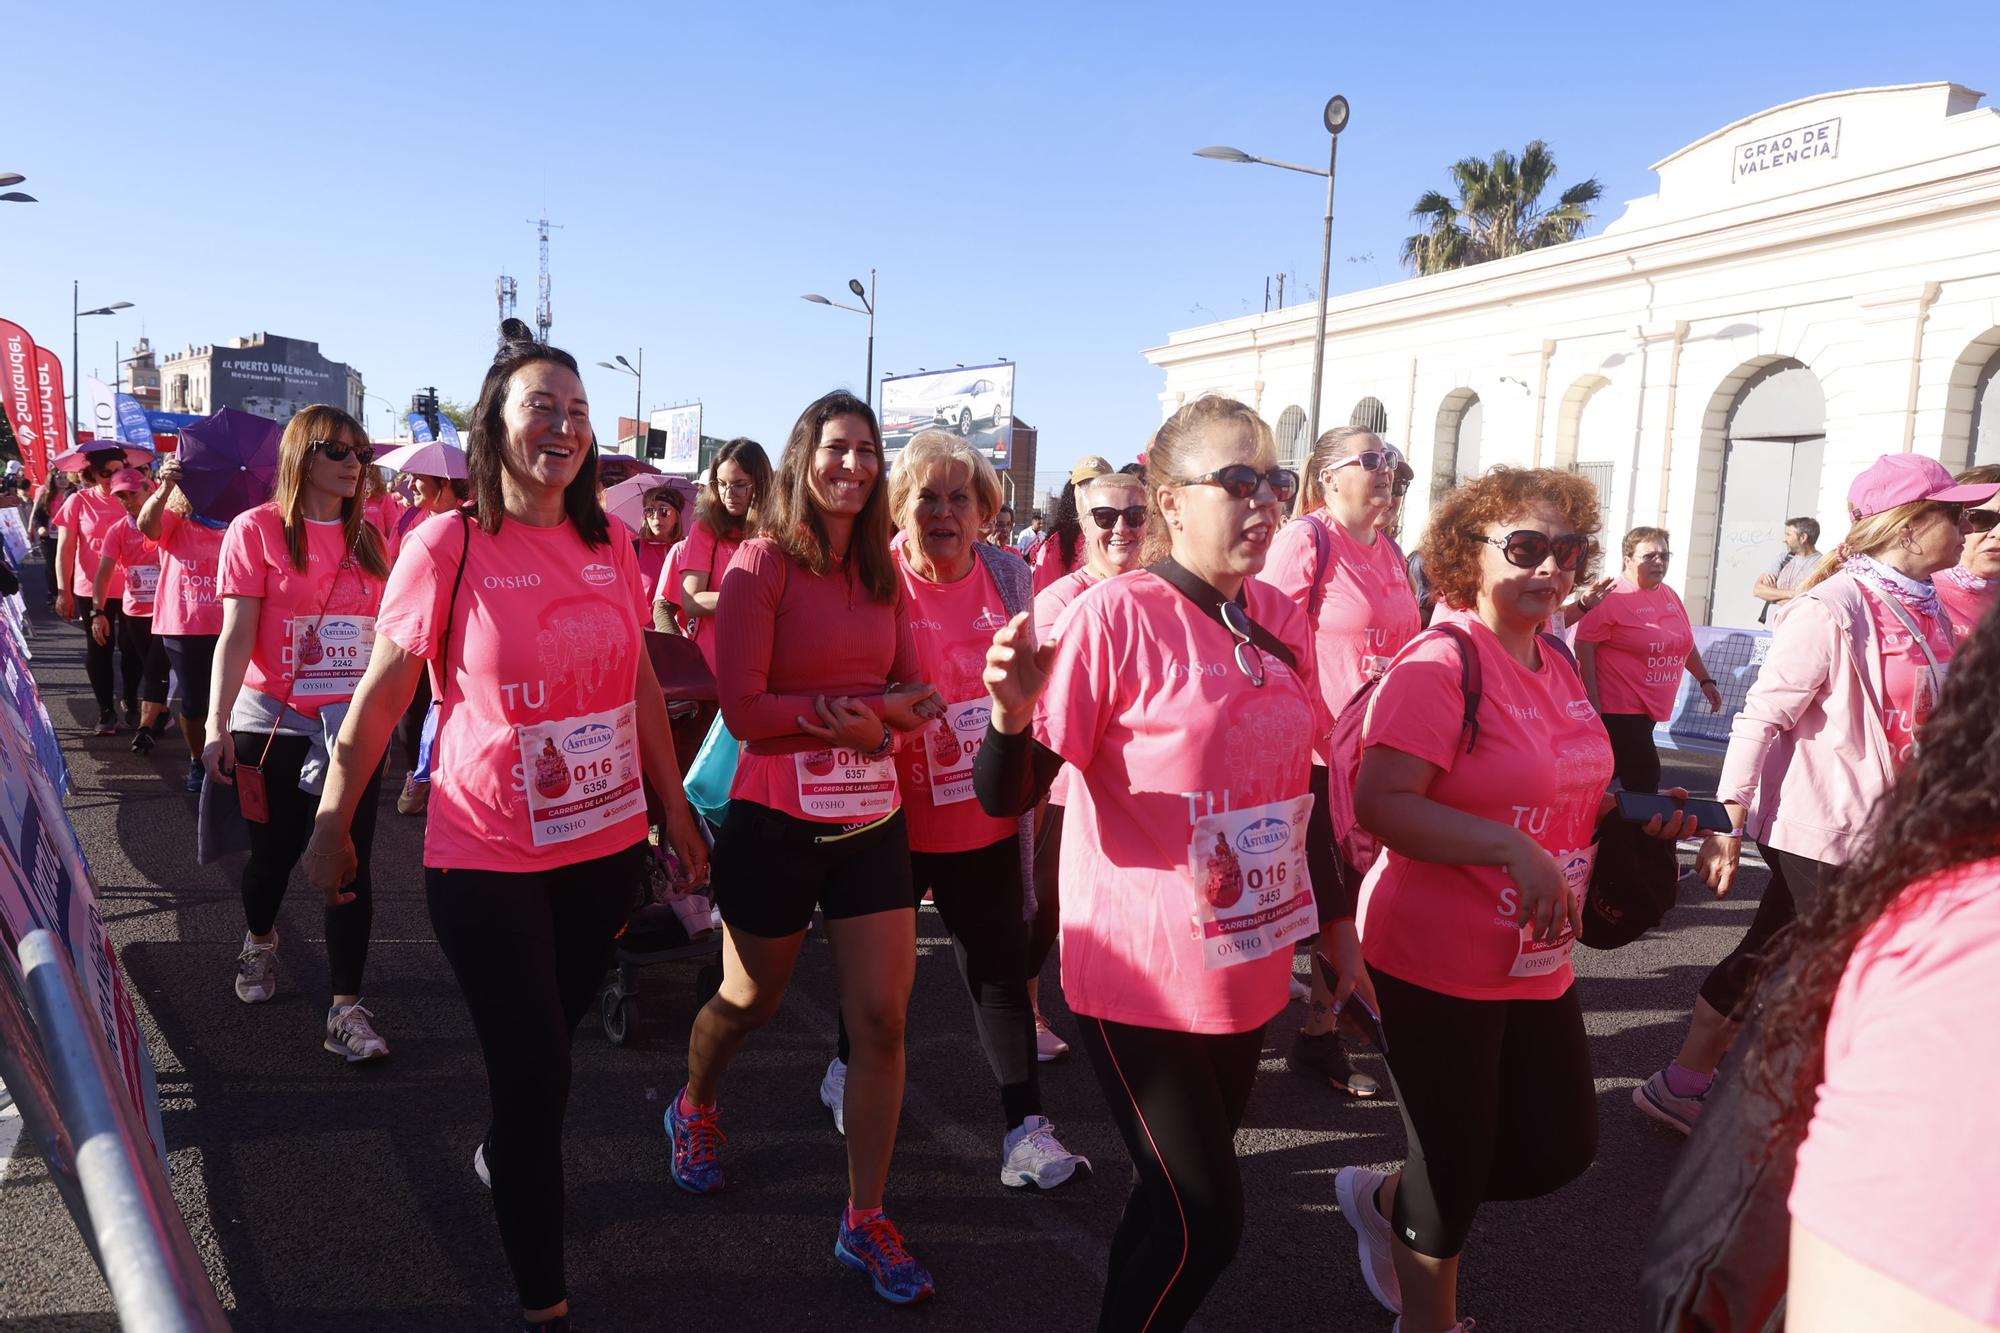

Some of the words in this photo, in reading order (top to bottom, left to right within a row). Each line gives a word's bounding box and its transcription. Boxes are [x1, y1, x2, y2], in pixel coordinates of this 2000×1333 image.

[1744, 137, 1792, 159] GRAO
[1803, 126, 1829, 144] DE
[1739, 142, 1830, 176] VALENCIA
[234, 360, 269, 372] PUERTO
[181, 560, 197, 572] TU
[484, 574, 540, 589] OYSHO
[1364, 628, 1387, 647] TU
[326, 646, 357, 658] 016
[1649, 642, 1665, 653] TU
[1171, 661, 1227, 678] OYSHO
[1646, 672, 1678, 682] SUMA
[302, 680, 333, 689] OYSHO
[501, 680, 545, 710] TU
[1885, 709, 1912, 732] TU
[568, 733, 610, 750] ASTURIANA
[963, 740, 982, 754] 01
[574, 758, 612, 782] 016
[845, 770, 866, 779] 6357
[944, 771, 972, 782] CARRERA
[583, 780, 608, 794] 6358
[944, 784, 975, 797] OYSHO
[548, 804, 584, 816] CARRERA
[604, 790, 622, 802] MUJER
[811, 800, 845, 809] OYSHO
[1181, 789, 1230, 825] TU
[547, 819, 586, 835] OYSHO
[610, 798, 637, 816] Santander
[1512, 806, 1549, 834] TU
[1242, 828, 1288, 849] ASTURIANA
[1247, 862, 1286, 889] 016
[1258, 889, 1281, 906] 3453
[1218, 917, 1257, 931] CARRERA
[1258, 914, 1266, 924] DE
[1267, 912, 1275, 920] LA
[1218, 936, 1262, 956] OYSHO
[1525, 956, 1555, 969] OYSHO
